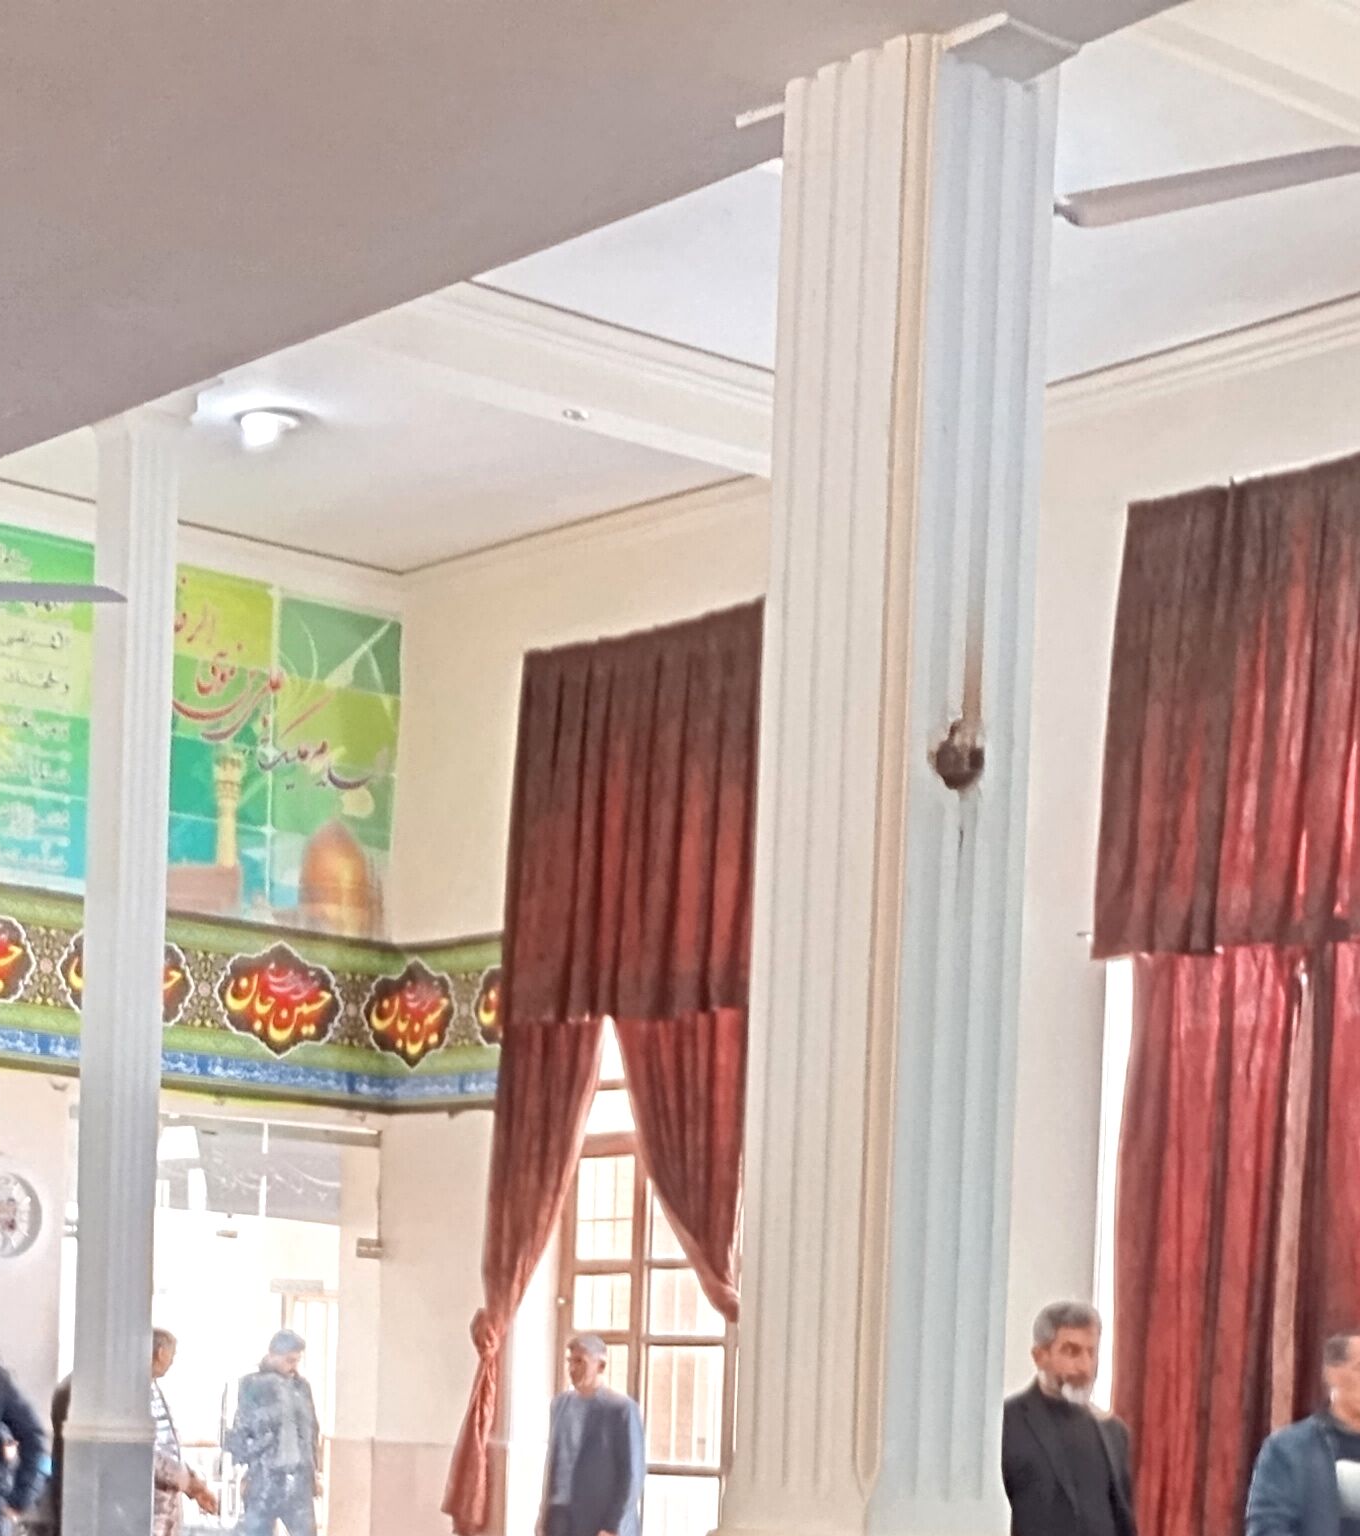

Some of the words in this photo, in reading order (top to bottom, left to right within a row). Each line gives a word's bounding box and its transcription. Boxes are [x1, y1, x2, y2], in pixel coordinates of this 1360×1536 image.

[225, 972, 276, 1032] جان
[267, 989, 332, 1042] حسین
[371, 993, 411, 1049] جان
[405, 996, 449, 1056] حسین
